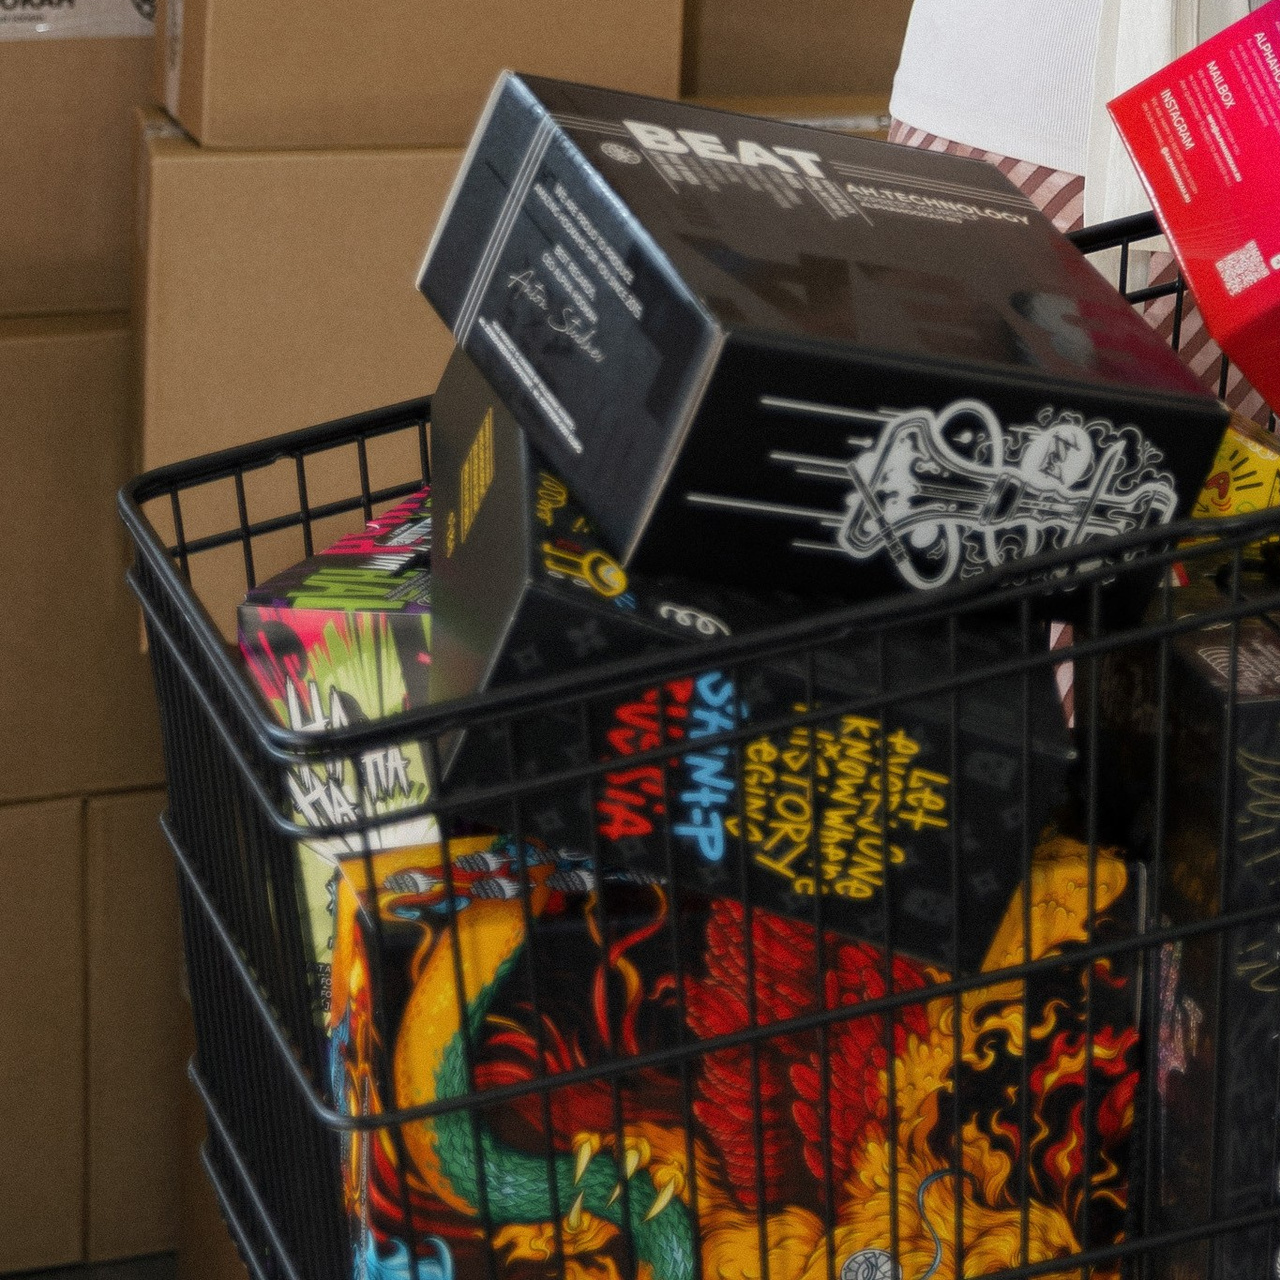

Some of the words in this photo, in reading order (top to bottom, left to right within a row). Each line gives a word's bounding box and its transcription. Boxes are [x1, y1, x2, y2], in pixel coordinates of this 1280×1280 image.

[1206, 60, 1236, 109] MAILBOX
[1160, 89, 1195, 150] INSTAGRAM
[621, 119, 823, 182] BEAT
